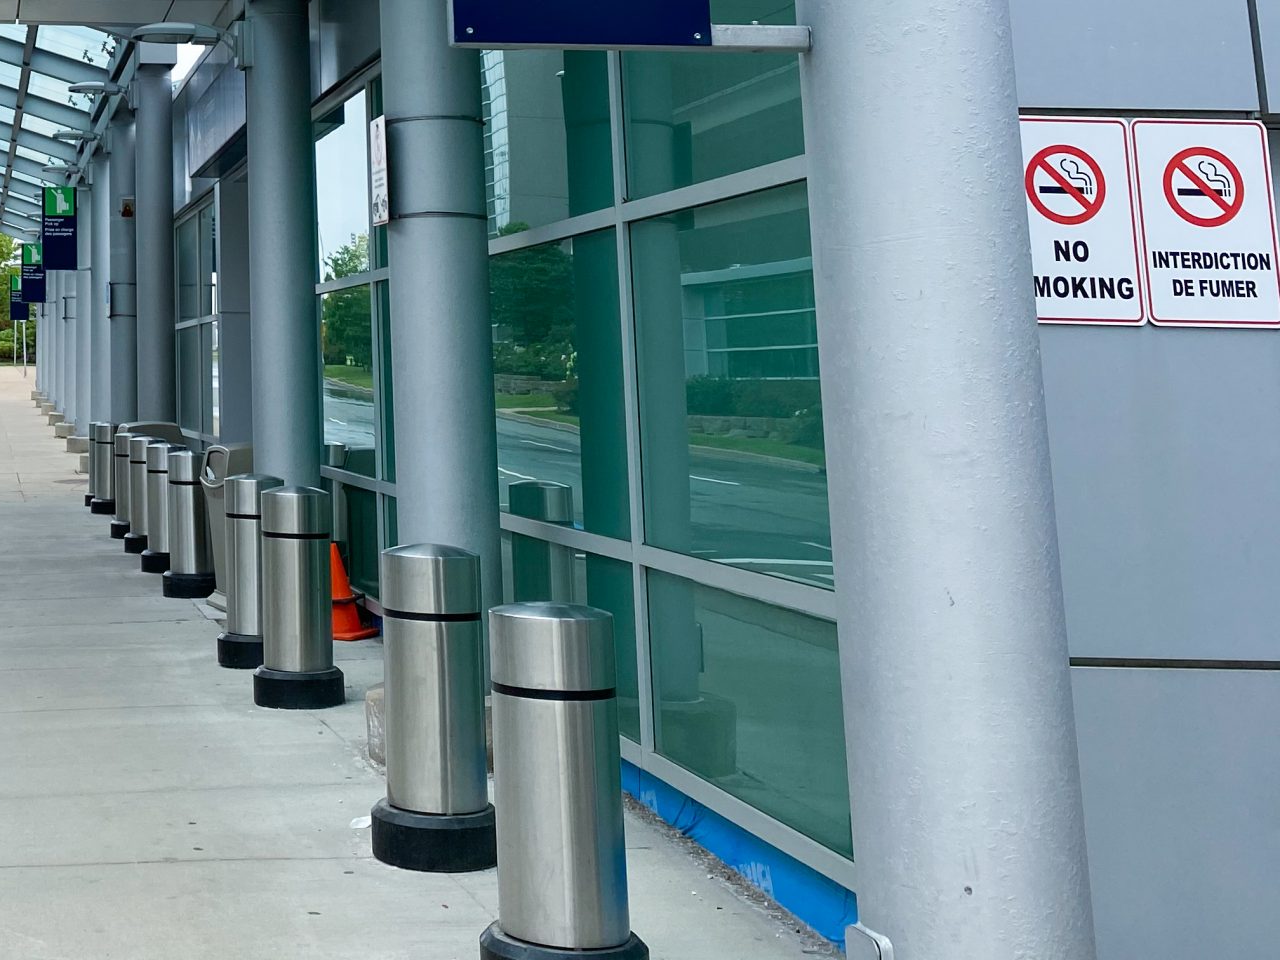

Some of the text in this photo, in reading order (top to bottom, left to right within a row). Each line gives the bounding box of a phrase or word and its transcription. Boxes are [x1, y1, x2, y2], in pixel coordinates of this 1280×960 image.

[1053, 240, 1089, 262] NO
[1152, 251, 1270, 270] INTERDICTION
[1033, 276, 1134, 300] MOKING
[1172, 279, 1258, 298] DE FUMER
